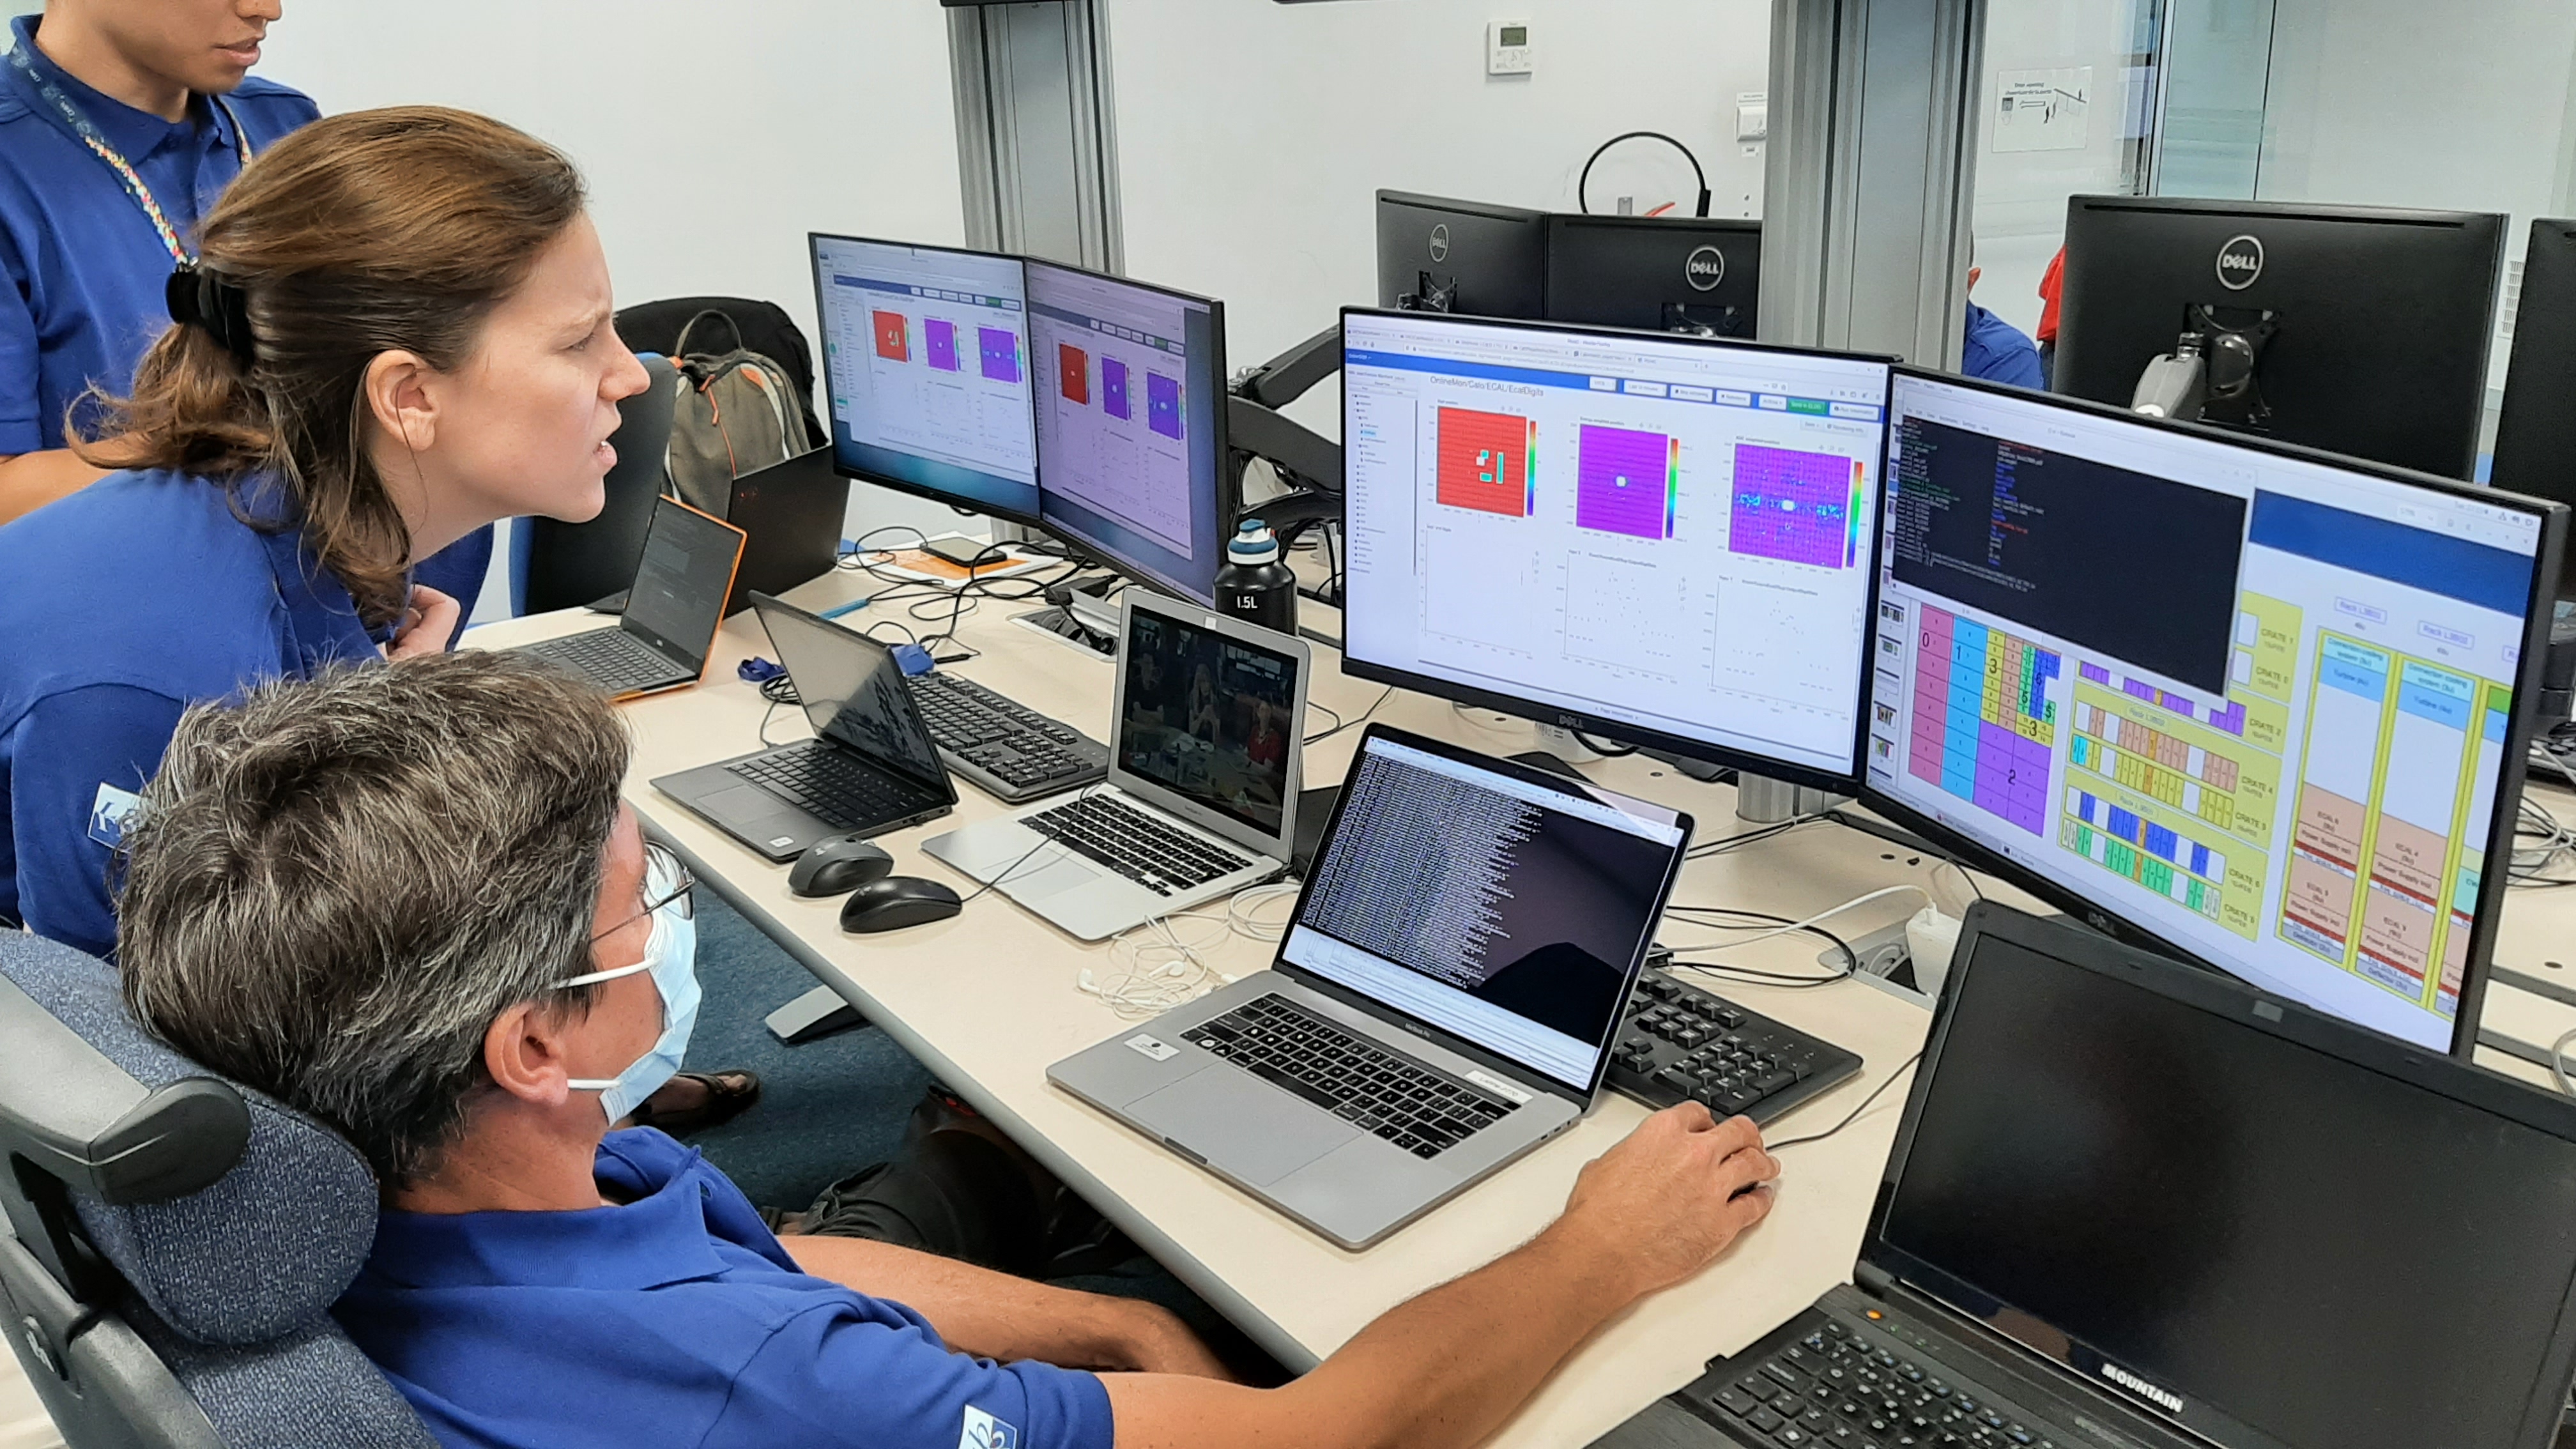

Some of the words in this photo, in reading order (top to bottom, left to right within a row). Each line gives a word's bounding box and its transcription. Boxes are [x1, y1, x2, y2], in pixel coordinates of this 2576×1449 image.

[1432, 237, 1445, 249] DELL
[1690, 261, 1719, 275] DELL
[2222, 254, 2257, 270] DELL
[1237, 595, 1258, 609] 1.5L
[1922, 632, 1930, 647] 0
[1956, 645, 1961, 661] 1
[1989, 658, 1998, 674] 3
[2035, 672, 2042, 686] 6
[2021, 690, 2030, 703] 5
[2044, 703, 2053, 719] 5
[2028, 720, 2038, 737] 3
[2007, 769, 2016, 786] 2
[2101, 1362, 2184, 1414] MOUNTAIN
